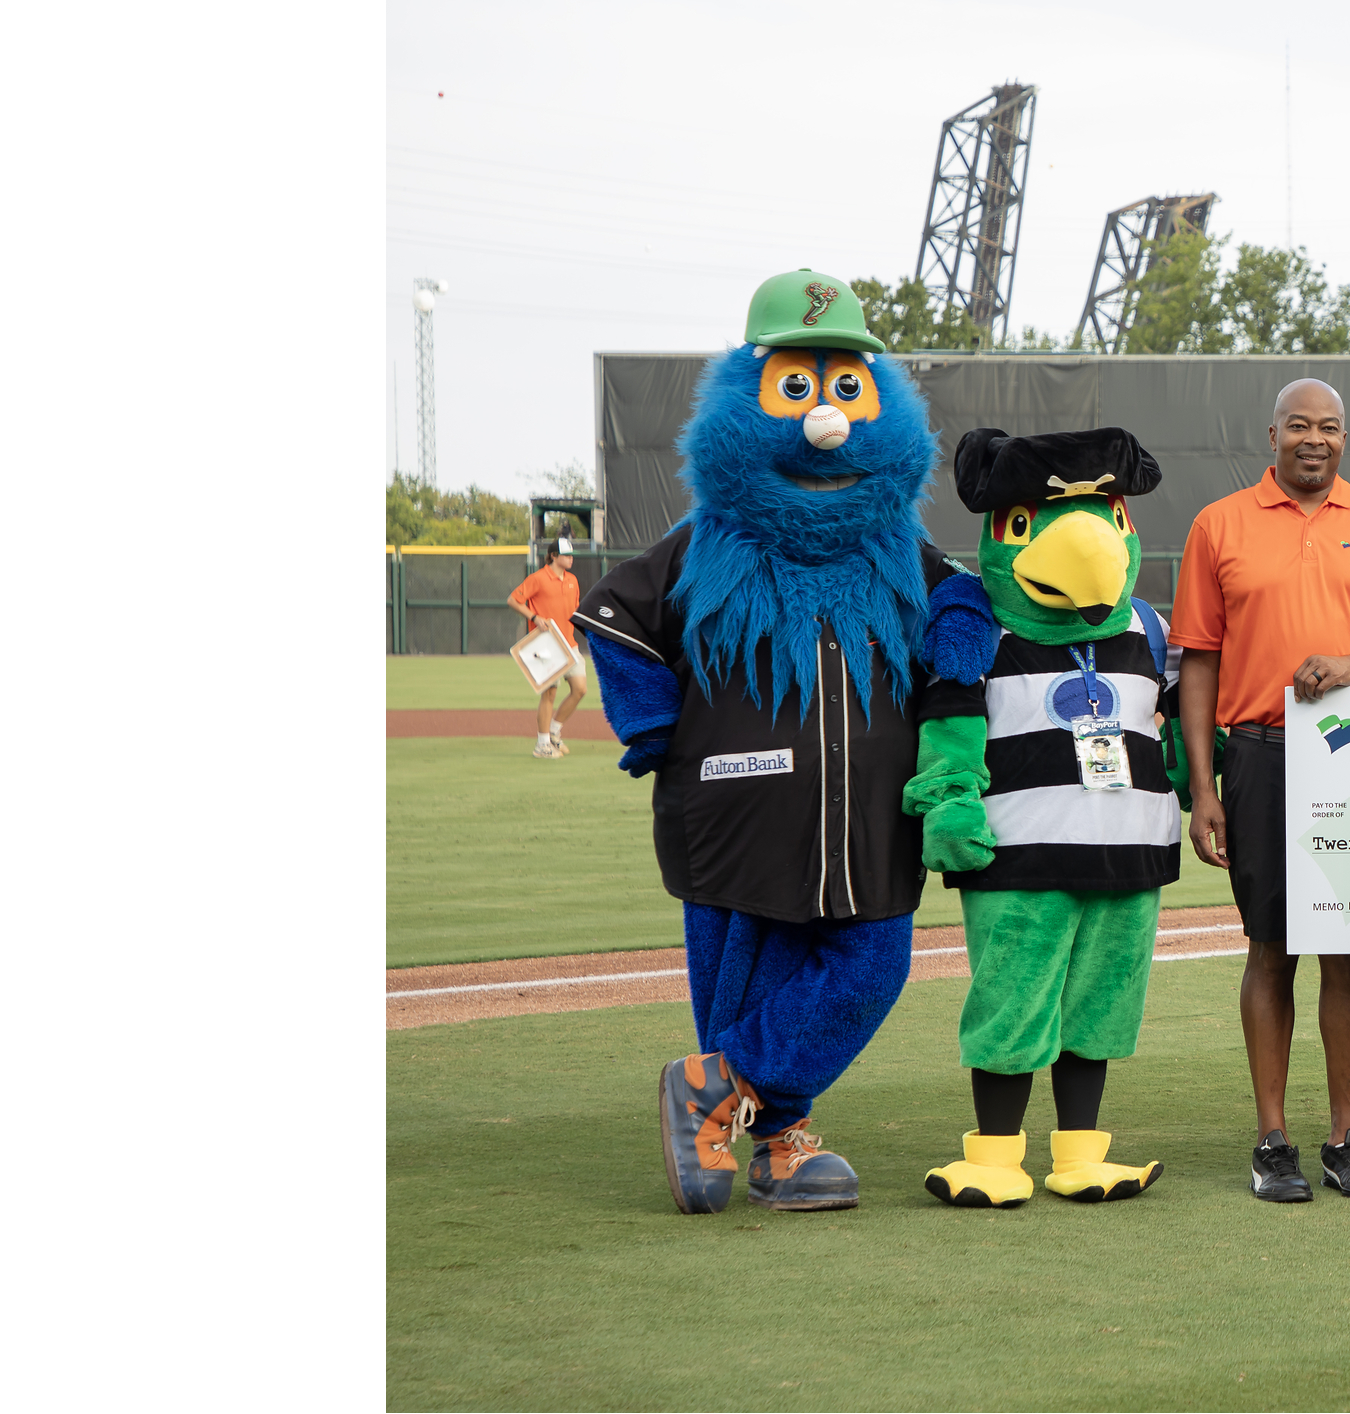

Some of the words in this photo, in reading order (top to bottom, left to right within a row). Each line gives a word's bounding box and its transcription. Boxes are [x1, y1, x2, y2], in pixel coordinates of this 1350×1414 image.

[1092, 722, 1118, 730] BayPort
[704, 760, 746, 776] Fulton
[747, 754, 788, 772] Bank
[1313, 903, 1344, 911] MEMO
